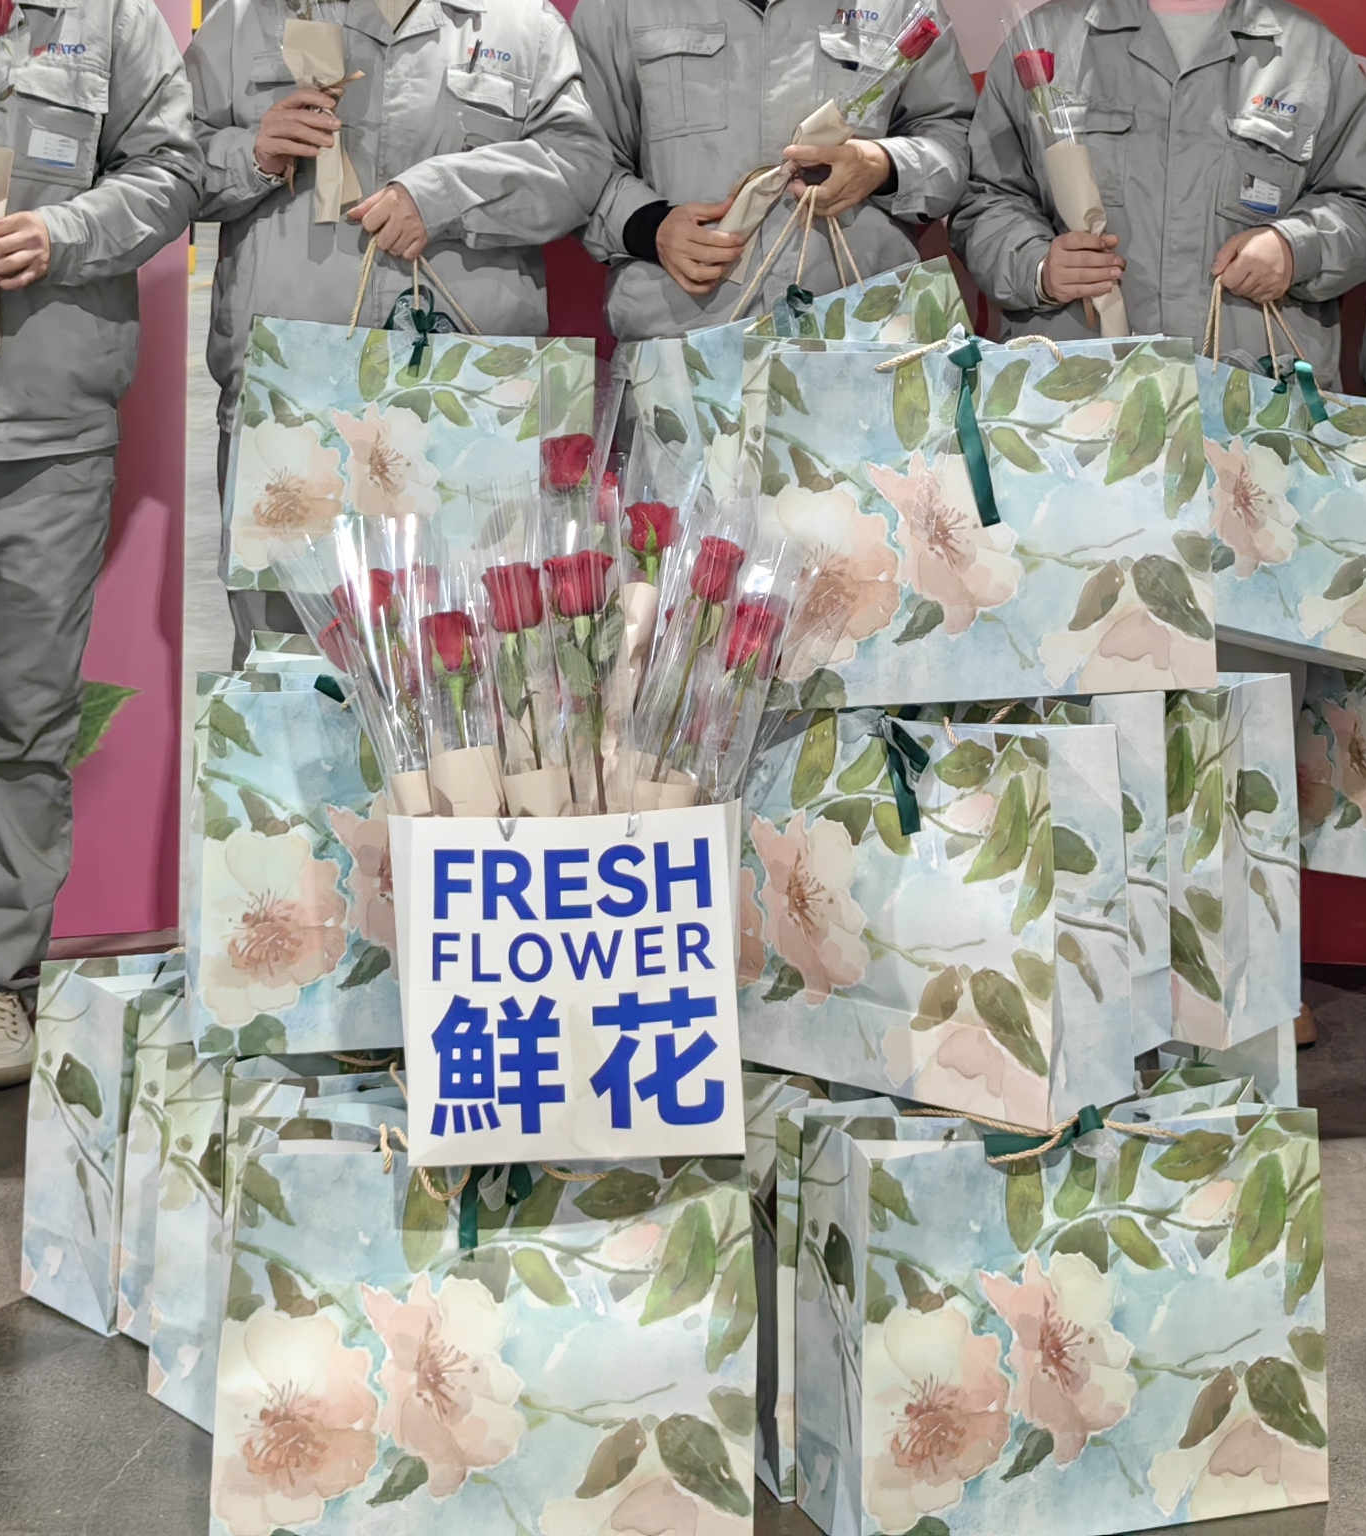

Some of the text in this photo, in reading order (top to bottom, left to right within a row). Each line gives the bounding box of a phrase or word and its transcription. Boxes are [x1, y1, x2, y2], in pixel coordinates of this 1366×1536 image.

[47, 43, 86, 55] RATO
[480, 48, 512, 62] RATO
[1263, 96, 1297, 113] RATO
[432, 836, 713, 921] FRESH
[431, 921, 715, 983] FLOWER
[429, 986, 725, 1137] 鮮花
